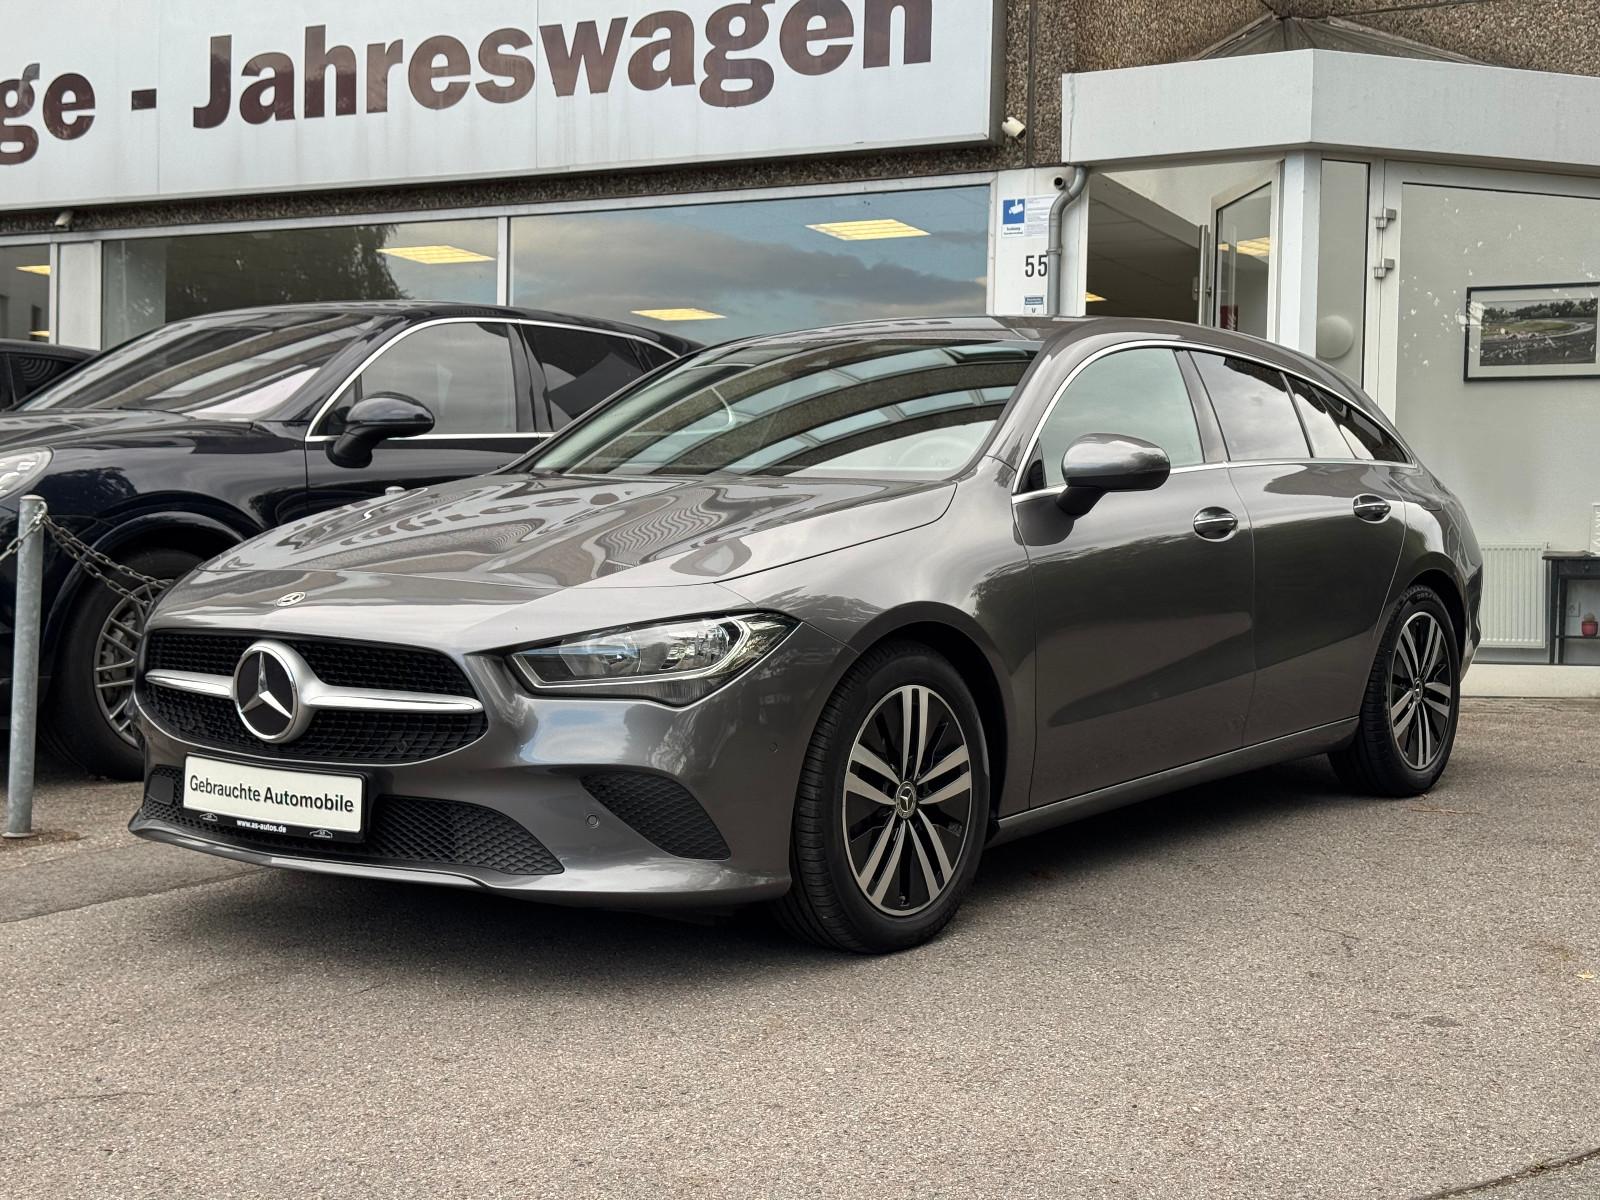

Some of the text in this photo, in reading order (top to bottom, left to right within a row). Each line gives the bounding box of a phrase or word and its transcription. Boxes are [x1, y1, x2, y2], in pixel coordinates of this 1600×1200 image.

[132, 88, 157, 111] -
[193, 0, 932, 129] Jahreswagen
[1025, 254, 1048, 278] 55
[190, 775, 354, 812] Gebrauchte Automobile
[236, 820, 287, 834] www.as-autos.de
